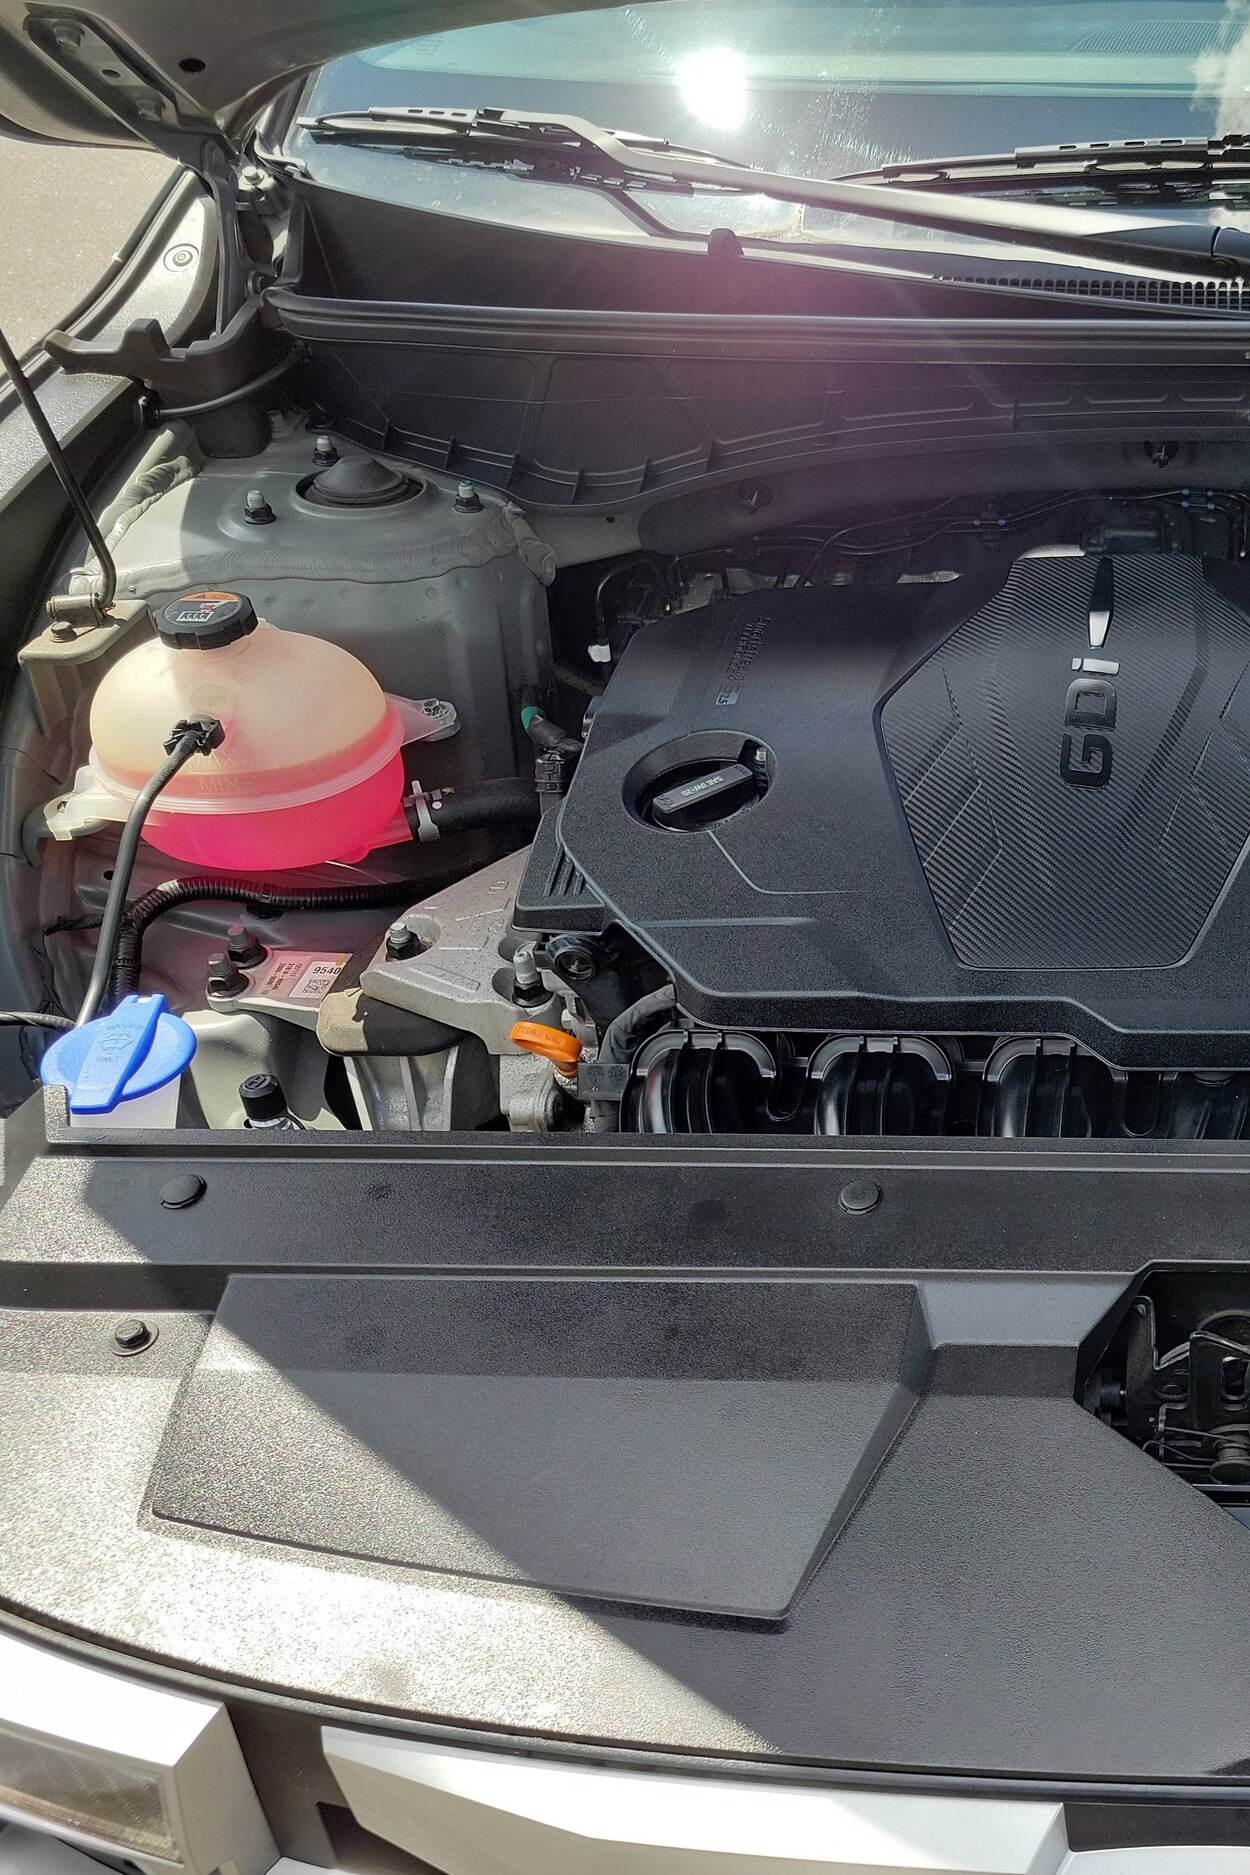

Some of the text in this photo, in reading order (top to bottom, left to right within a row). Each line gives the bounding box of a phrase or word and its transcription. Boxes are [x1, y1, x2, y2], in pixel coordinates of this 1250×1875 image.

[198, 777, 240, 792] MIN
[705, 776, 724, 787] SAE
[312, 966, 342, 975] 9540
